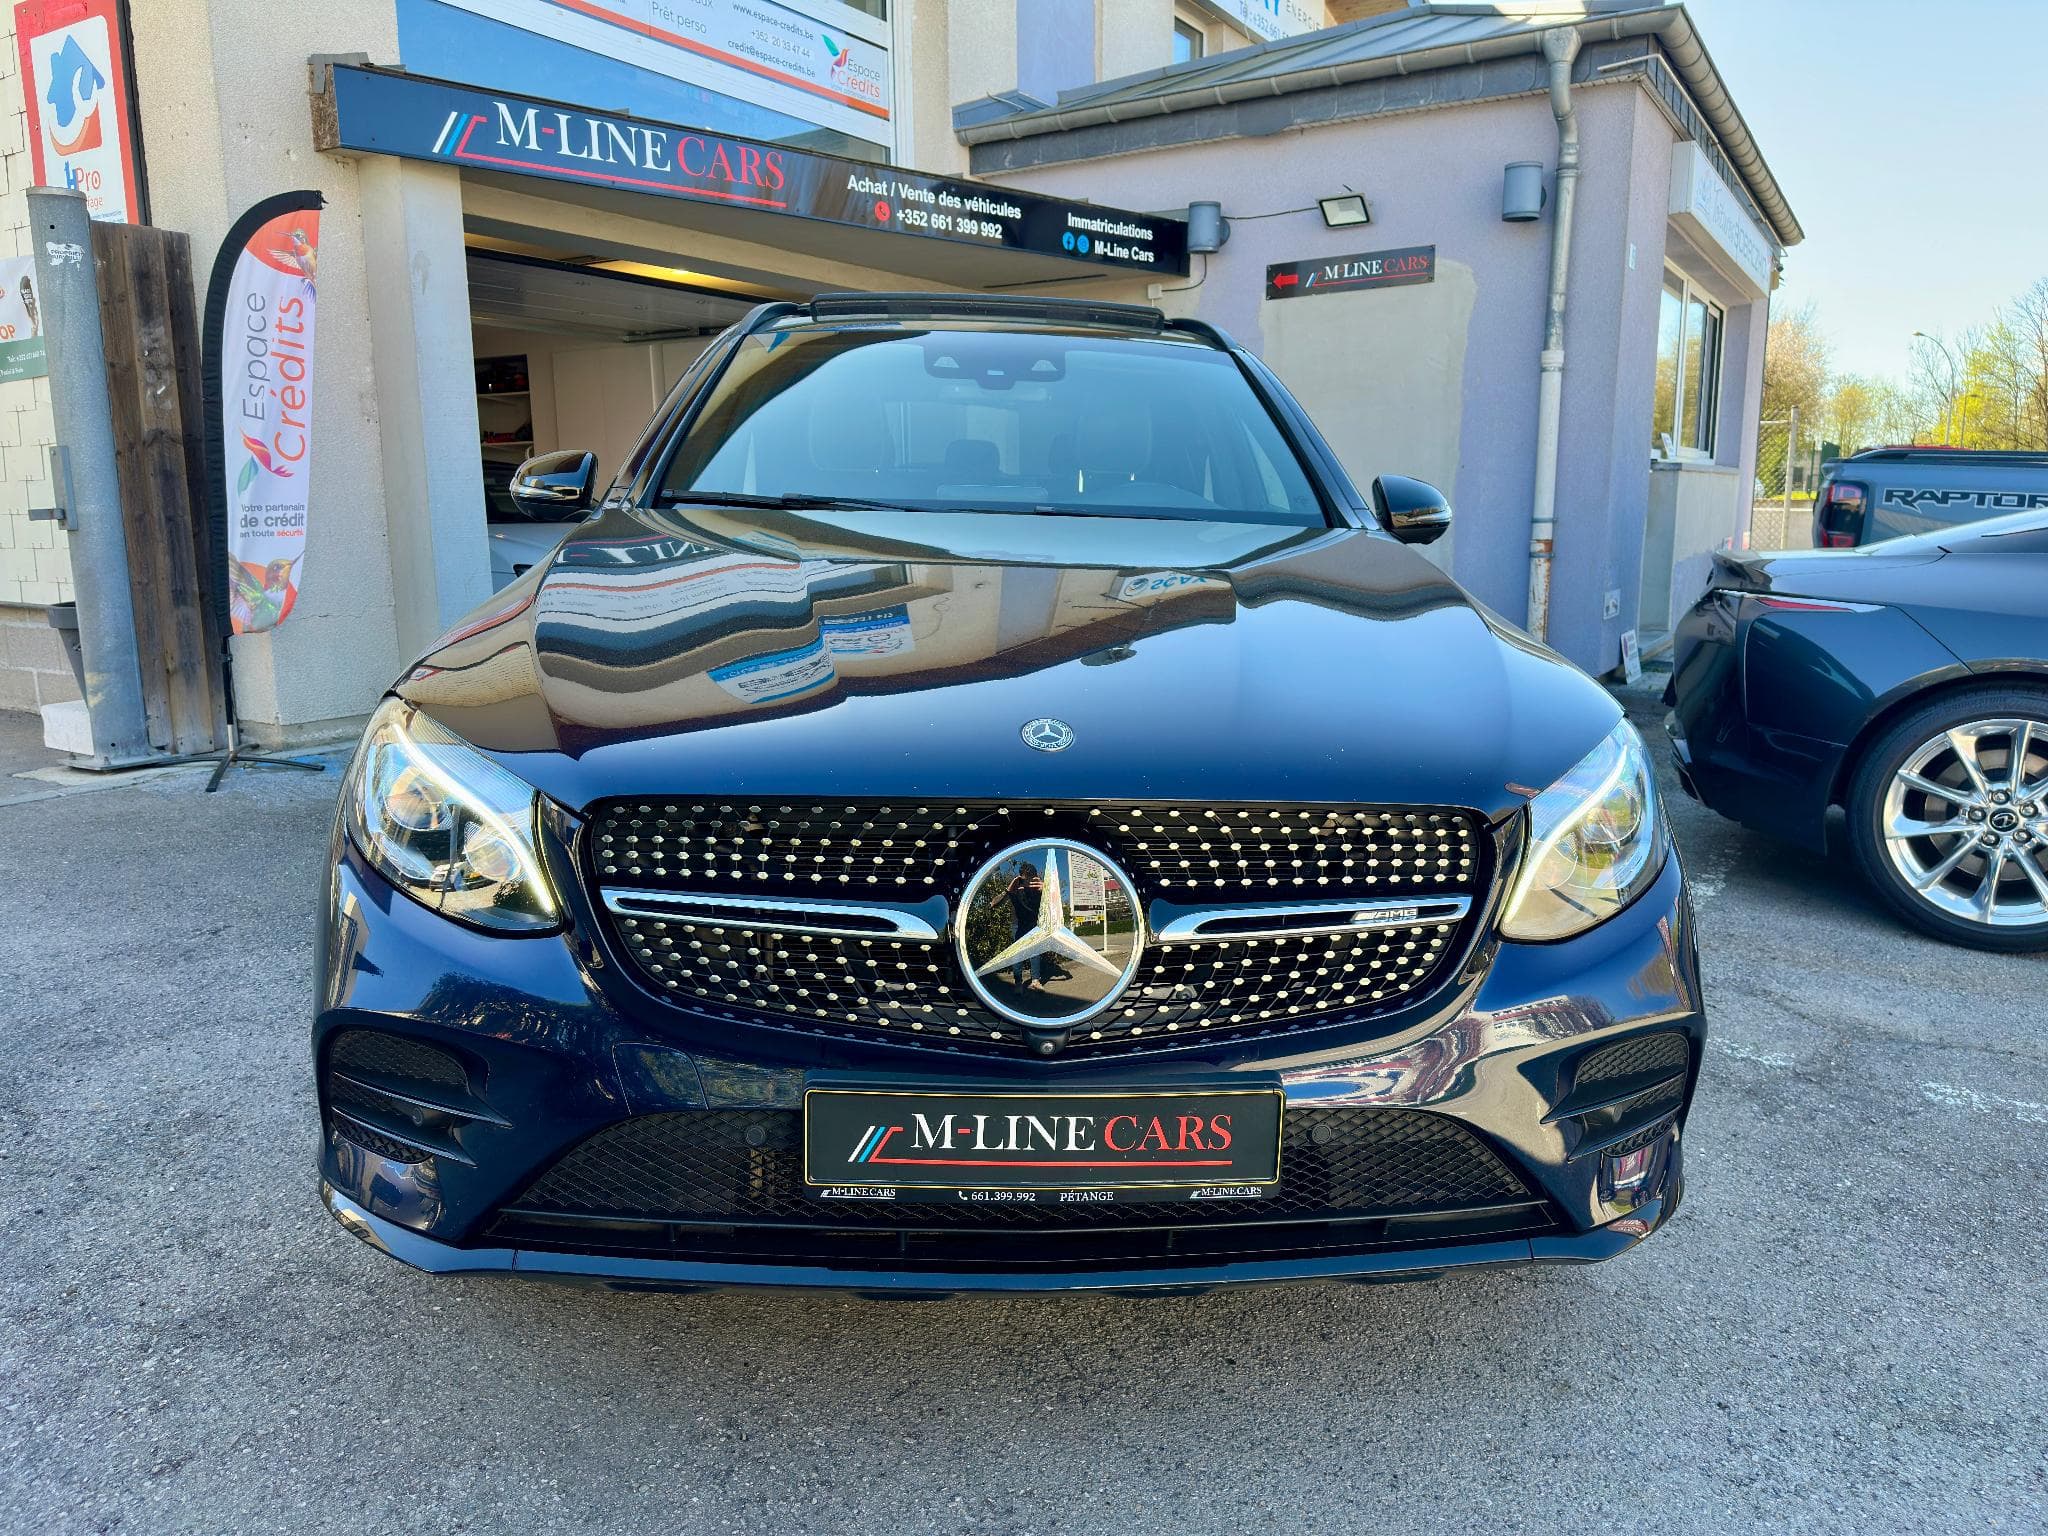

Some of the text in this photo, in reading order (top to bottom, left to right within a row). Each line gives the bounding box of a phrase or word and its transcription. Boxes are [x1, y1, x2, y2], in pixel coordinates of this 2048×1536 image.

[652, 2, 708, 34] Prêt perso
[732, 3, 814, 41] www.espace-credits.be
[727, 39, 816, 79] credit@espace-credits.be
[847, 58, 881, 81] Espace
[492, 101, 785, 190] M-LINE CARS
[847, 174, 888, 197] Achat
[899, 182, 936, 205] Vente
[939, 190, 962, 209] des
[964, 196, 1022, 220] véhicules
[896, 209, 1003, 239] +352 661 399 992
[1067, 212, 1154, 241] Immatriculations
[1094, 239, 1155, 263] M-Line Cars
[1324, 255, 1430, 280] M-LINE CARS
[242, 292, 270, 421] Espace
[270, 296, 306, 462] Crédits
[240, 513, 304, 528] de crédit
[241, 504, 263, 512] Votre
[911, 1113, 1233, 1151] M-LINE CARS
[869, 1188, 896, 1198] CARS
[971, 1191, 1036, 1201] 661.399.992
[1059, 1190, 1114, 1202] PÉTANGE
[1237, 1186, 1262, 1196] CARS
